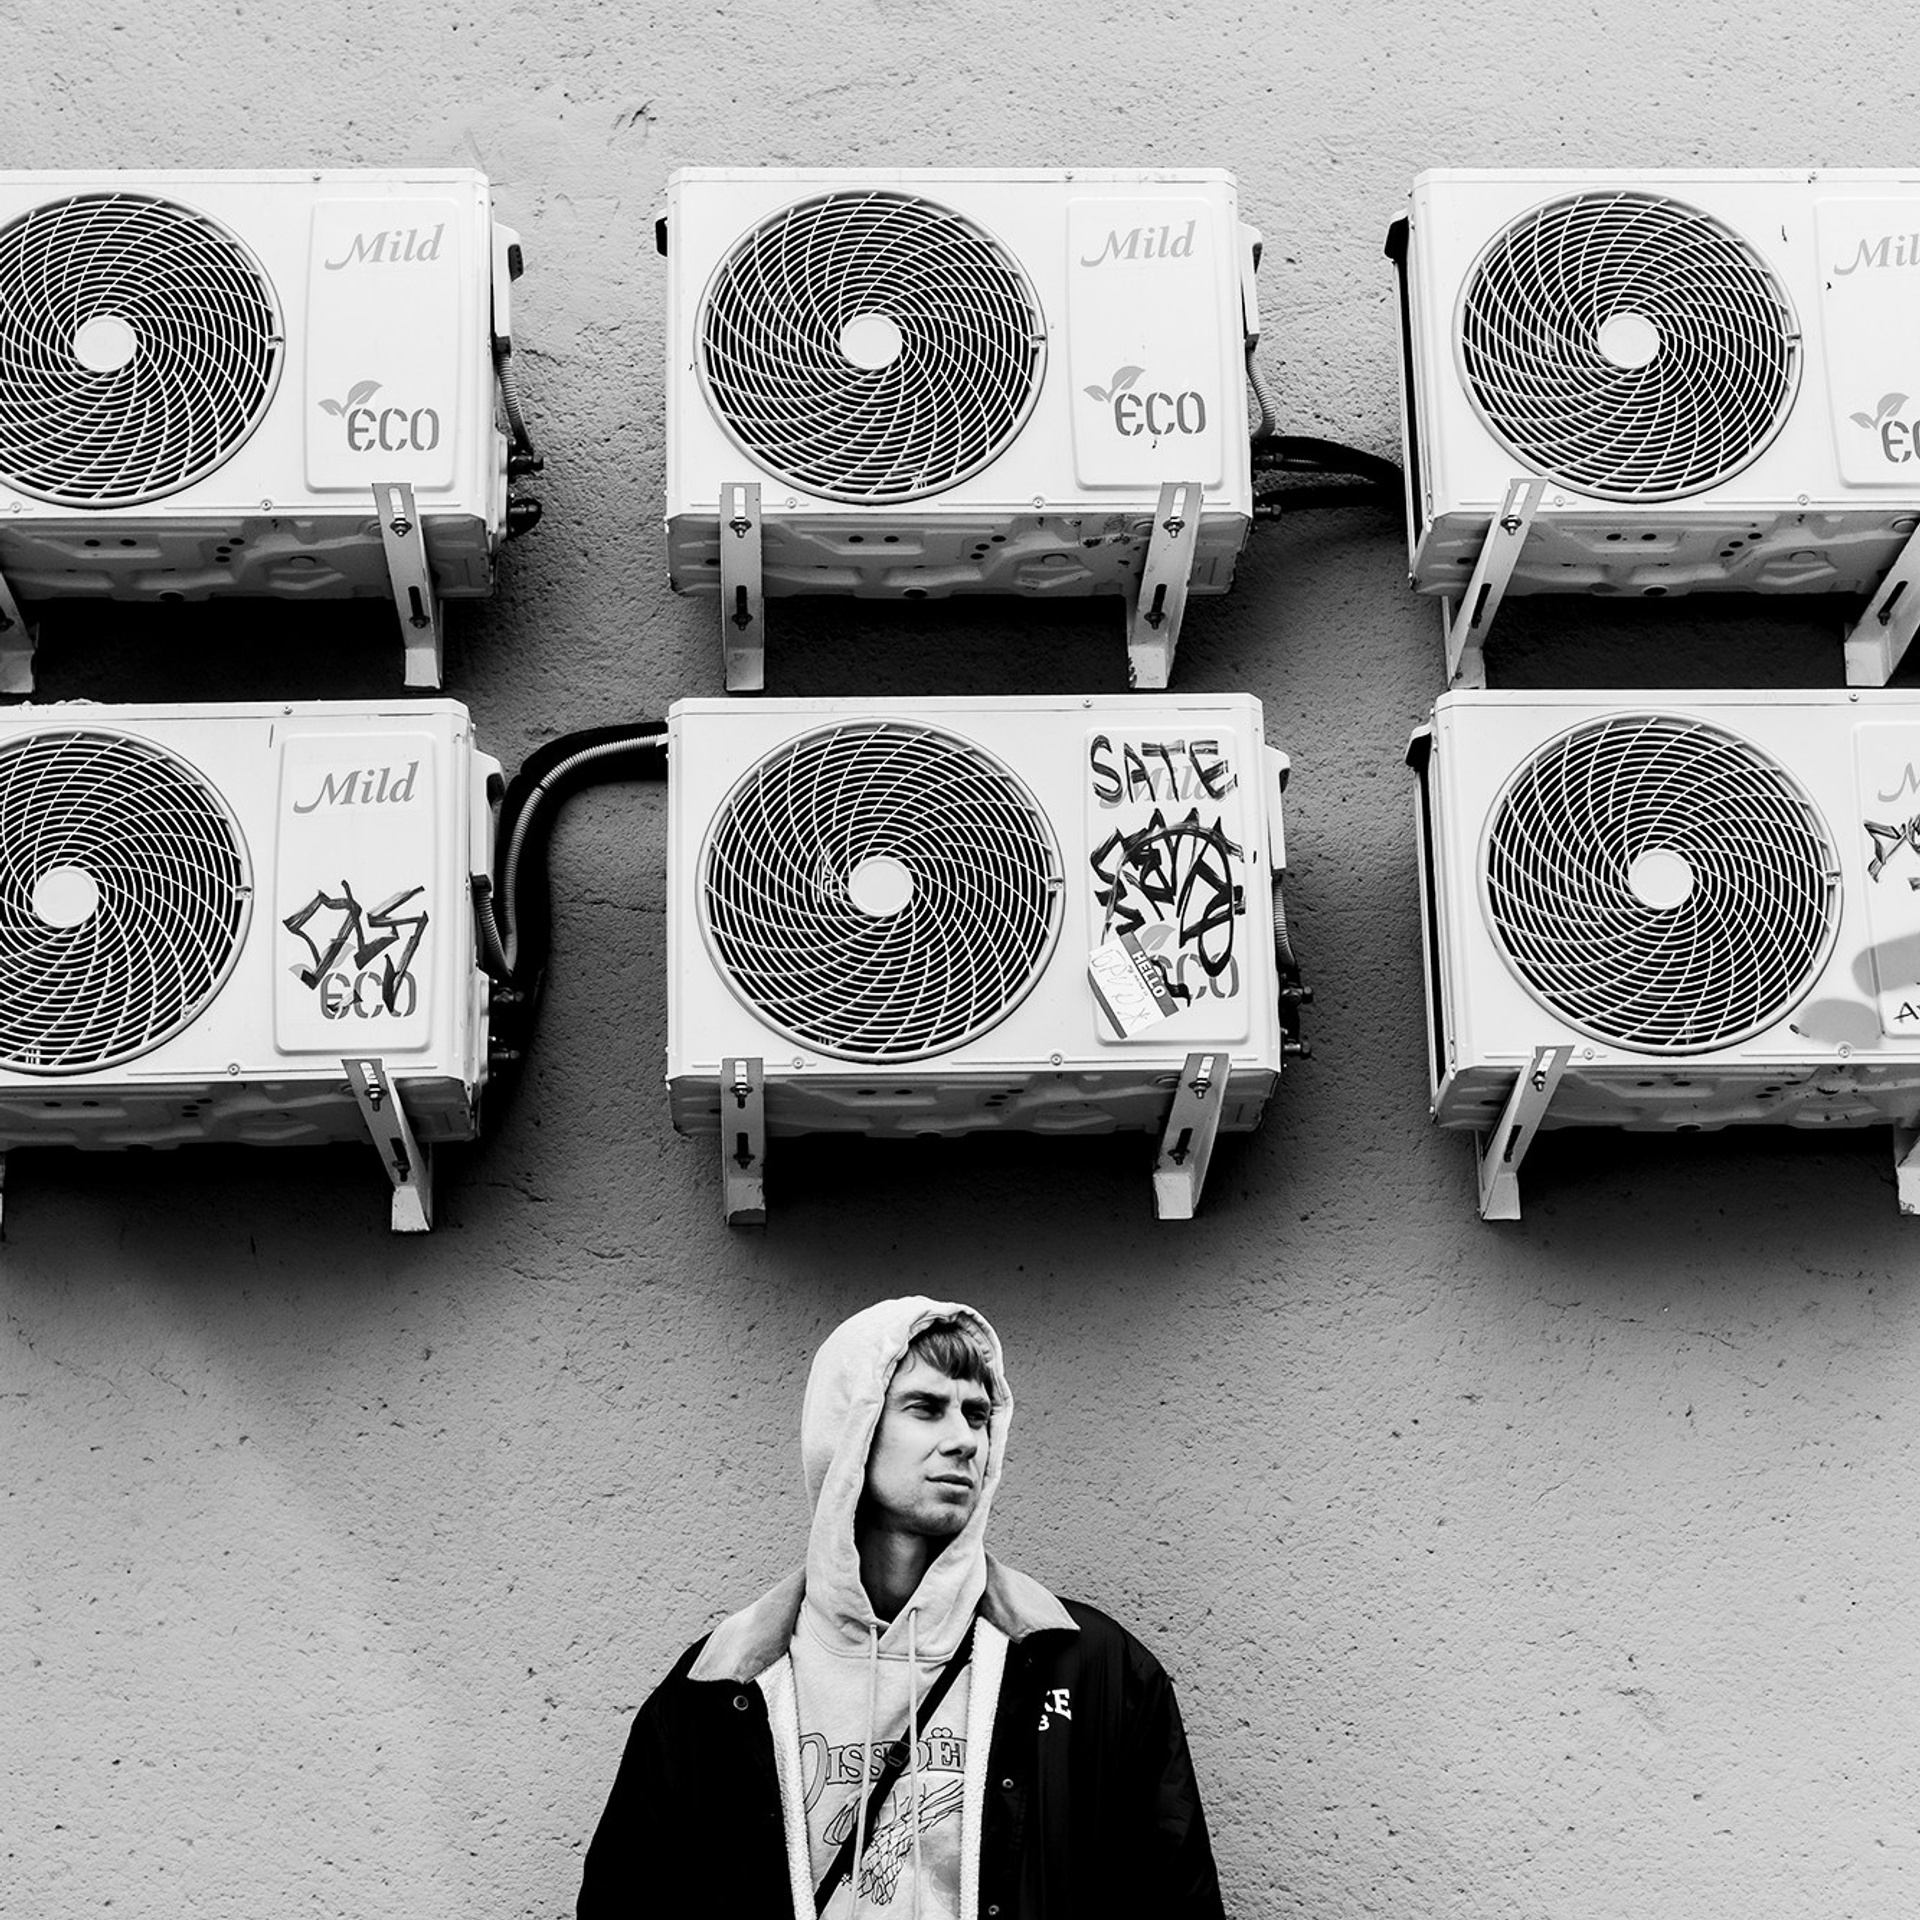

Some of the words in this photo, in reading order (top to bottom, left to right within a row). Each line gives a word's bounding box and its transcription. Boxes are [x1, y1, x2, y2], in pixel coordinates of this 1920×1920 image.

[324, 222, 445, 271] Mild
[1080, 219, 1196, 267] Mild
[347, 407, 440, 452] ECO
[1114, 390, 1207, 437] ECO
[293, 760, 419, 814] Mild
[1131, 950, 1167, 998] HELLO
